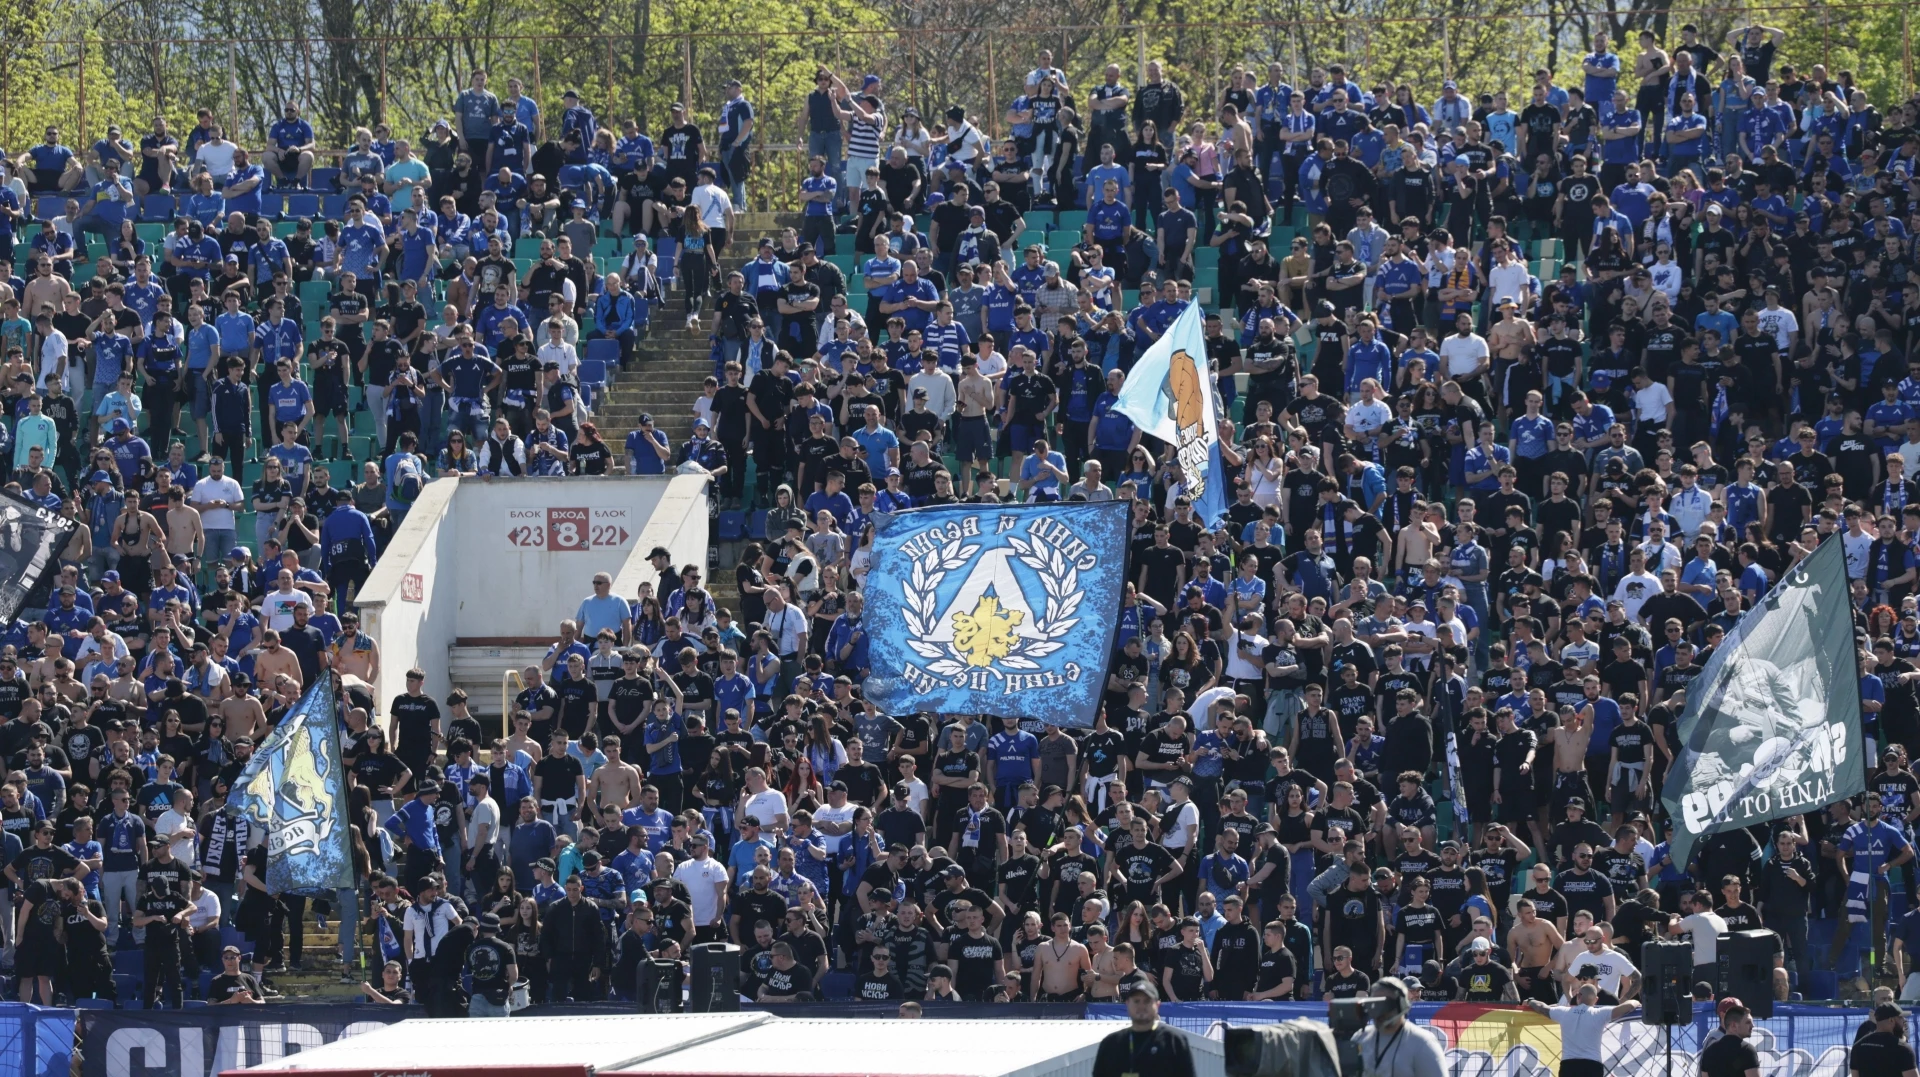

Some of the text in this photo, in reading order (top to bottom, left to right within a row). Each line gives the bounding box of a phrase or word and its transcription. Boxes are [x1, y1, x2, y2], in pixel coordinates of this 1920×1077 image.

[1759, 315, 1783, 324] WEST
[510, 510, 541, 519] БЛОК
[551, 511, 586, 520] ВХОД
[594, 510, 627, 518] БЛОК
[519, 526, 545, 547] 23
[557, 521, 580, 547] 8
[591, 525, 617, 546] 22
[1123, 669, 1134, 679] 25
[1126, 716, 1147, 731] 1914
[1879, 783, 1907, 792] ULTRAS
[1005, 870, 1028, 880] ellesse
[864, 982, 887, 991] НОВИ
[861, 989, 889, 999] ИСКЪР
